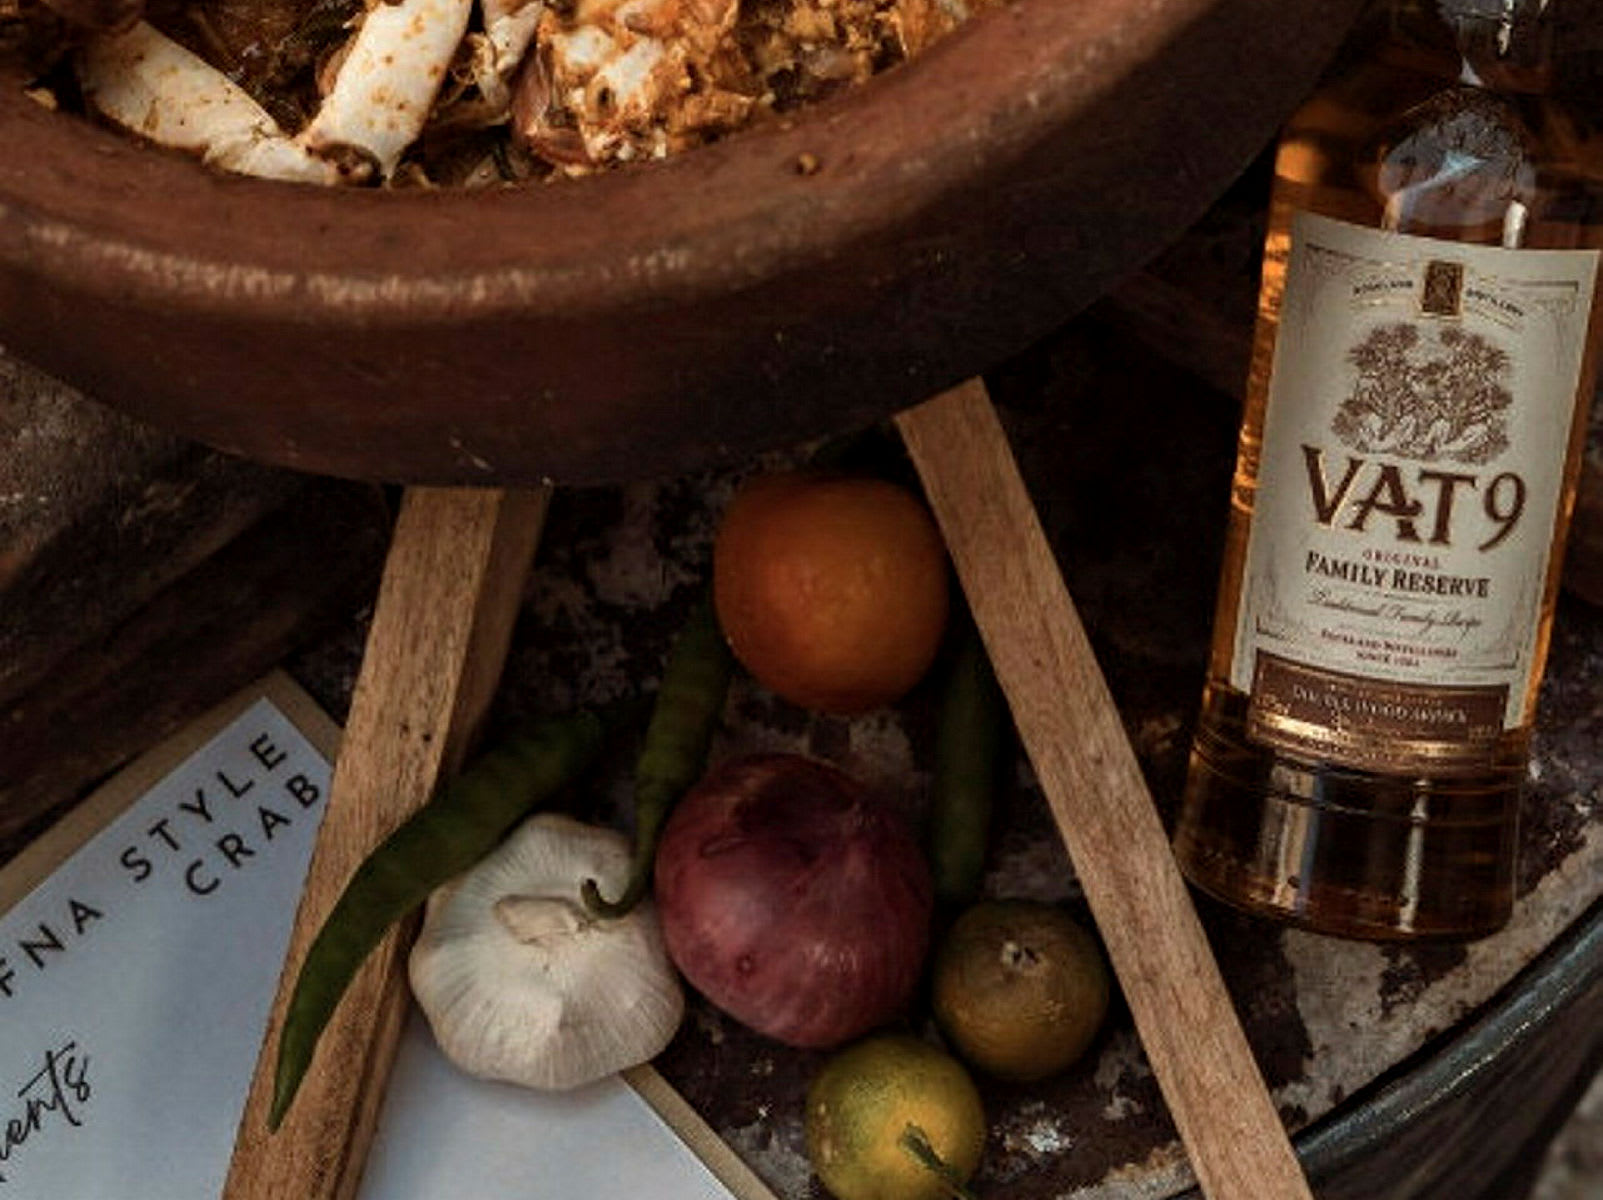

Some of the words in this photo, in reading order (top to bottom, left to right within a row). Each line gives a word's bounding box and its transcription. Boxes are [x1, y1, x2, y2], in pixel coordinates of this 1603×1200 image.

[1301, 443, 1477, 545] VAT
[1478, 471, 1527, 553] 9
[1305, 550, 1389, 587] FAMILY
[1392, 568, 1492, 598] RESERVE
[120, 733, 288, 883] STYLE
[185, 774, 321, 896] CRAB
